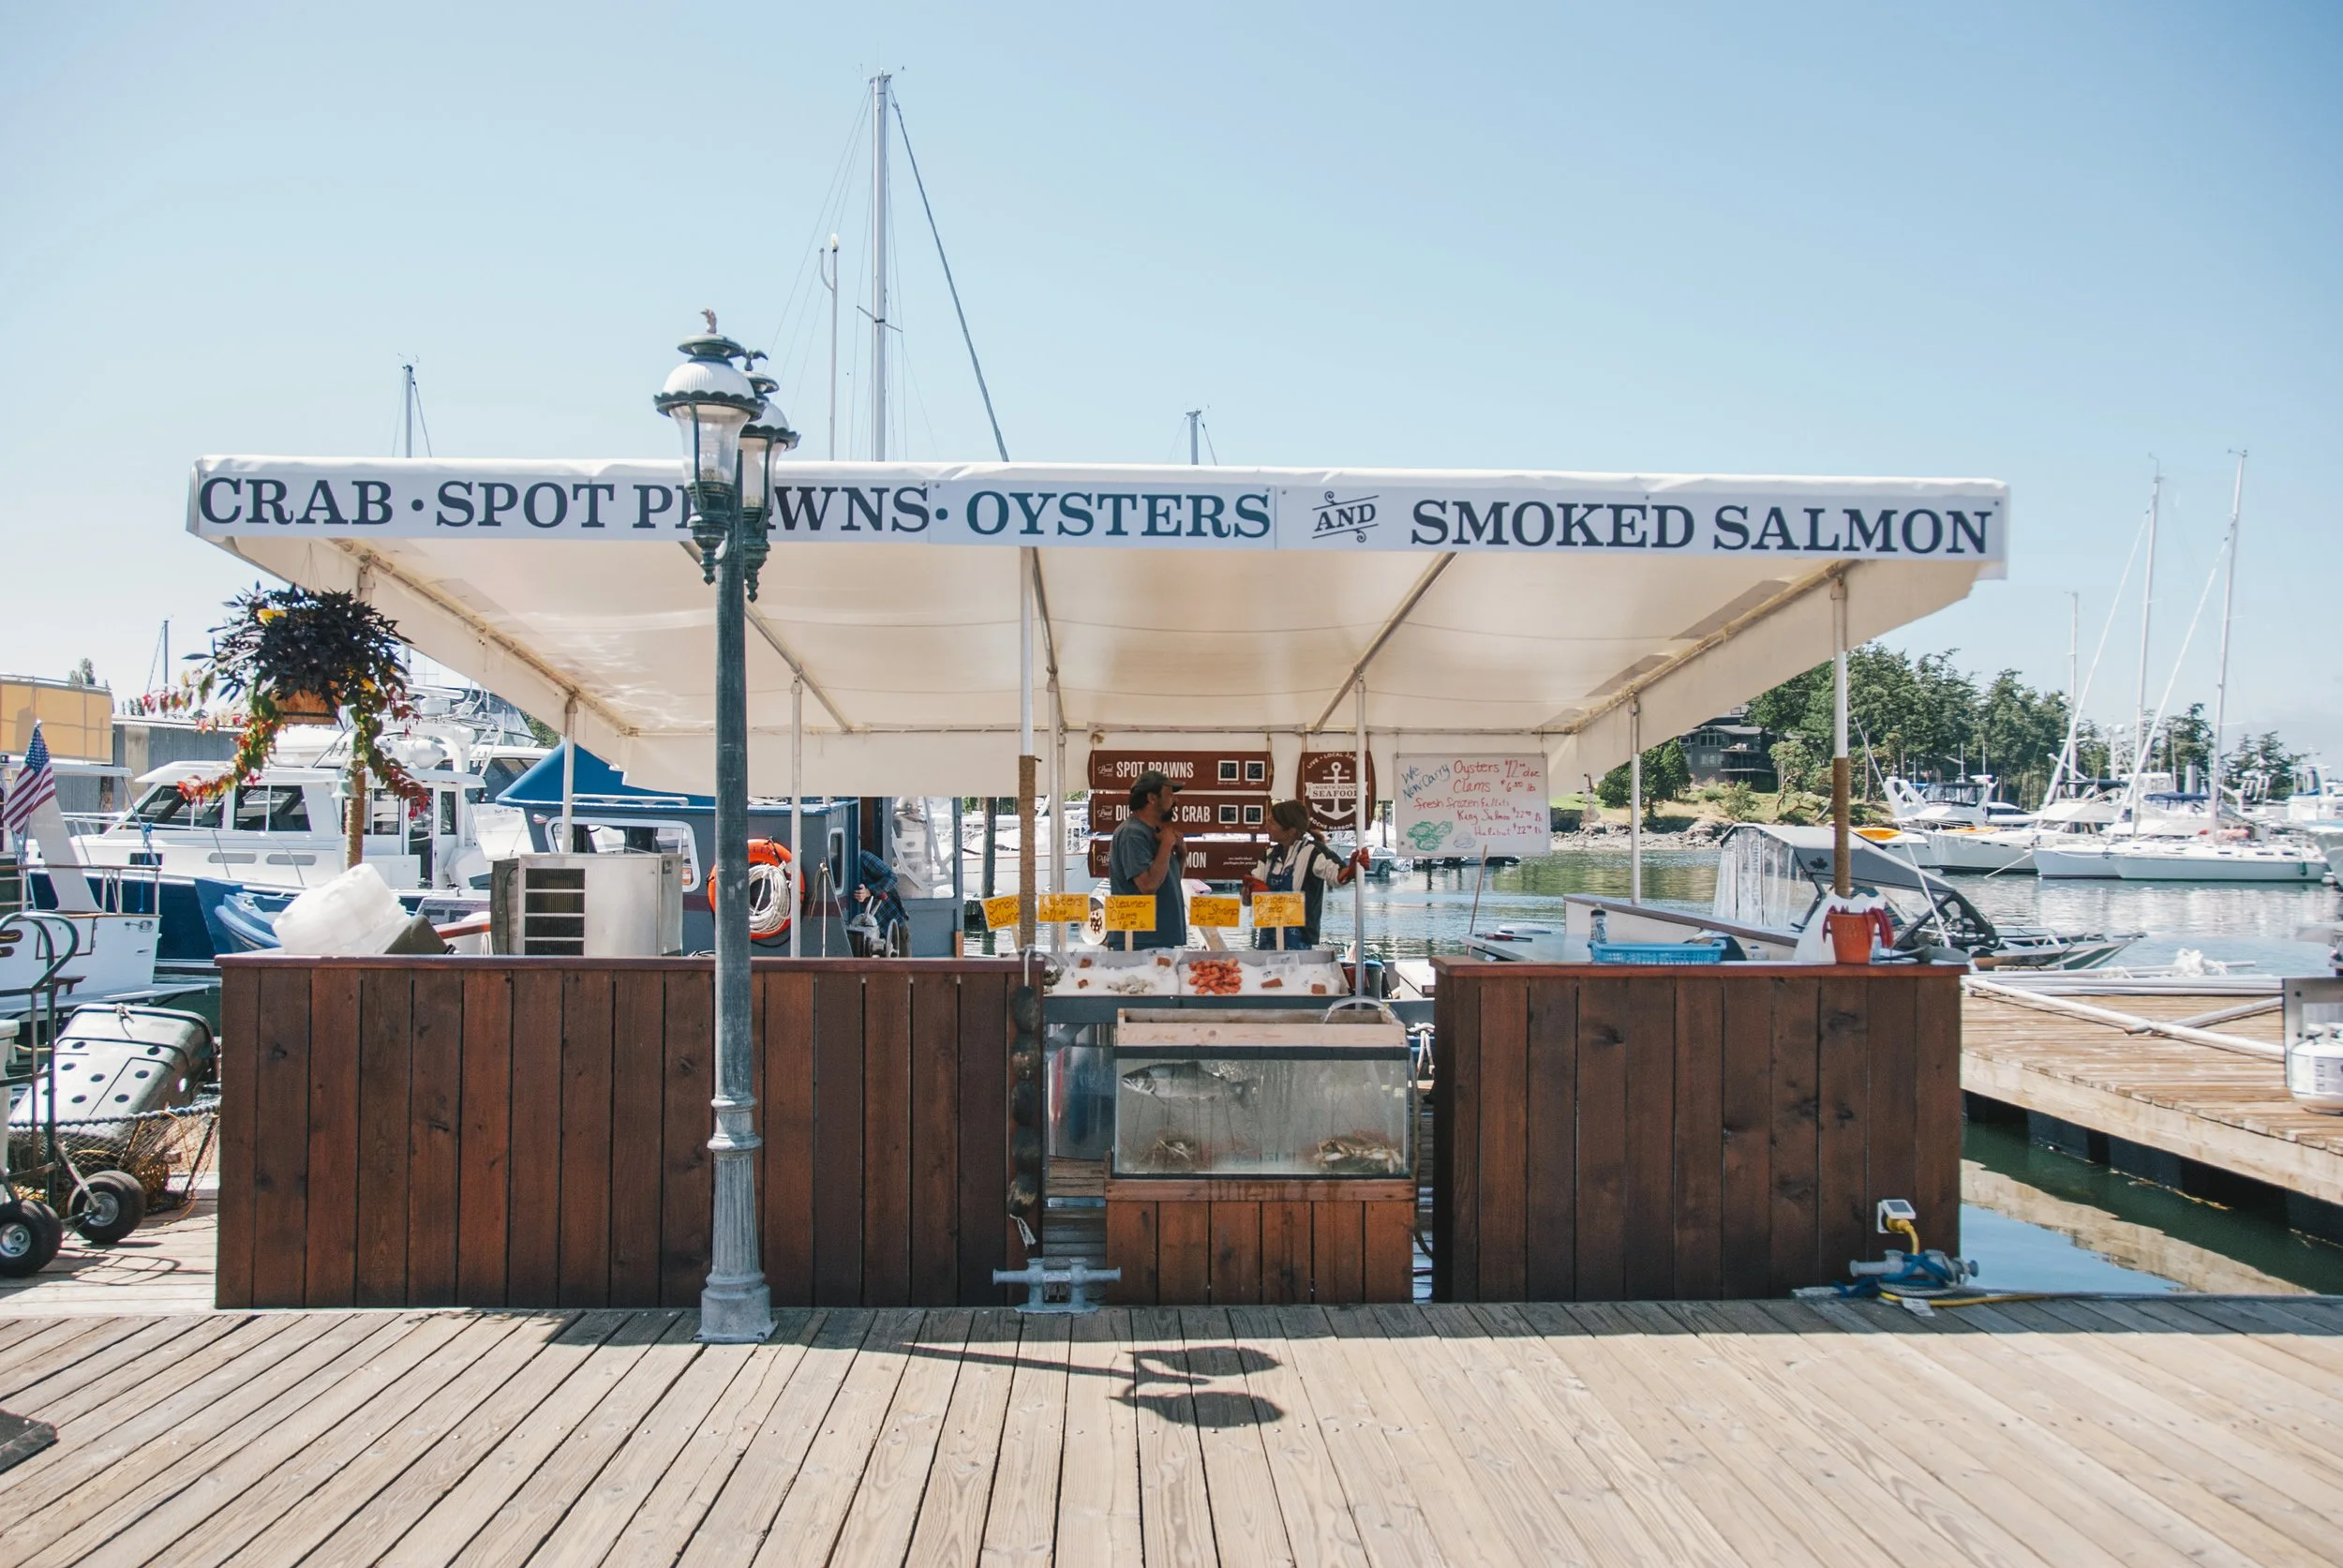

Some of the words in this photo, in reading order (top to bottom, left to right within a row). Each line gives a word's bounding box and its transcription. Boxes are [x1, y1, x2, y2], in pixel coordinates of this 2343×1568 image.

[199, 477, 393, 526] CRAB
[436, 480, 615, 530] SPOT
[633, 484, 931, 533] PWNS
[965, 490, 1271, 539] OYSTERS
[1314, 502, 1377, 532] AND
[1410, 499, 1695, 548] SMOKED
[1713, 504, 1993, 555] SALMON
[1116, 761, 1144, 778] SPOT
[1401, 764, 1420, 784] We
[1422, 764, 1451, 787] Carry
[1454, 759, 1500, 780] Oysters
[1453, 779, 1491, 794] Clams
[1527, 784, 1536, 792] lb
[1446, 797, 1478, 810] frozen
[1182, 805, 1211, 822] CRAB
[1109, 896, 1151, 909] Steamer
[1110, 909, 1138, 921] Clams
